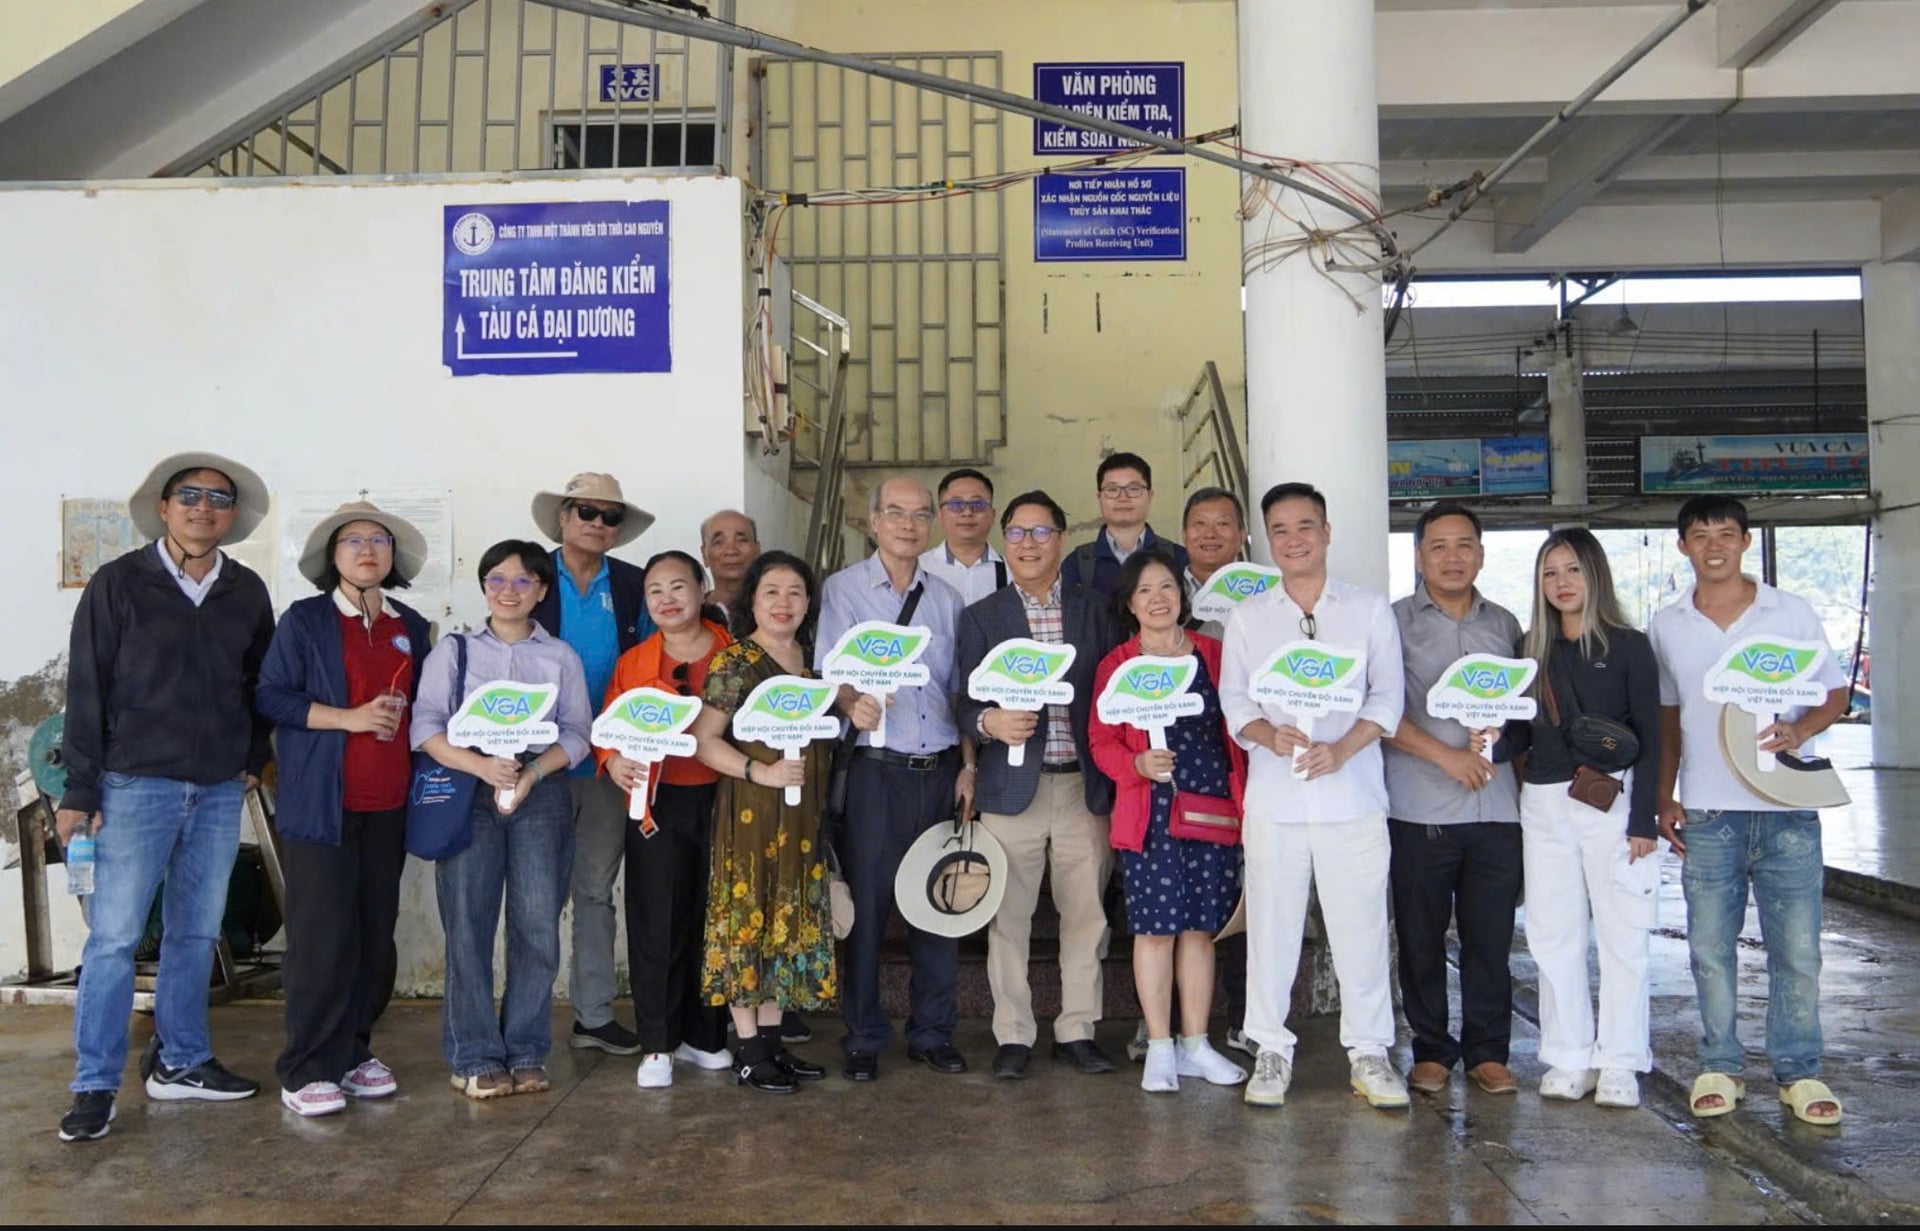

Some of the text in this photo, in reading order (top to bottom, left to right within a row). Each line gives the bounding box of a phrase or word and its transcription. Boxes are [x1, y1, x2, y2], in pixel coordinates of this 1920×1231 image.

[607, 87, 650, 99] WC
[1062, 71, 1156, 96] VĂN PHÒNG
[1106, 99, 1140, 121] KIỂM
[1143, 104, 1173, 122] TRA,
[1044, 125, 1077, 147] KIỂM
[1084, 178, 1102, 190] TIẾP
[1104, 179, 1126, 190] NHẬN
[1059, 193, 1080, 204] NHẬN
[1110, 190, 1126, 202] GỐC
[1128, 191, 1160, 202] NGUYÊN
[1161, 190, 1180, 203] LIỆU
[1110, 207, 1129, 216] KHAI
[1130, 205, 1152, 216] THÁC
[624, 222, 637, 236] CAO
[638, 219, 664, 236] NGUYÊN
[1092, 226, 1116, 236] Catch
[1117, 226, 1135, 237] (SC)
[1137, 226, 1180, 236] Verification
[1065, 239, 1094, 248] Profiles
[1095, 239, 1132, 250] Receiving
[460, 254, 656, 298] TRUNG TÂM ĐĂNG KIỂM
[479, 304, 636, 344] TÀU CÁ ĐẠI DƯƠNG
[1224, 578, 1266, 596] VGA
[856, 638, 903, 656] VGA
[1002, 655, 1048, 675] VGA
[1286, 656, 1335, 680] VGA
[1742, 651, 1796, 673] VGA
[1126, 671, 1175, 691] VGA
[1461, 669, 1509, 690] VGA
[481, 697, 530, 715] VGA
[766, 693, 813, 710] VGA
[628, 702, 672, 726] VGA
